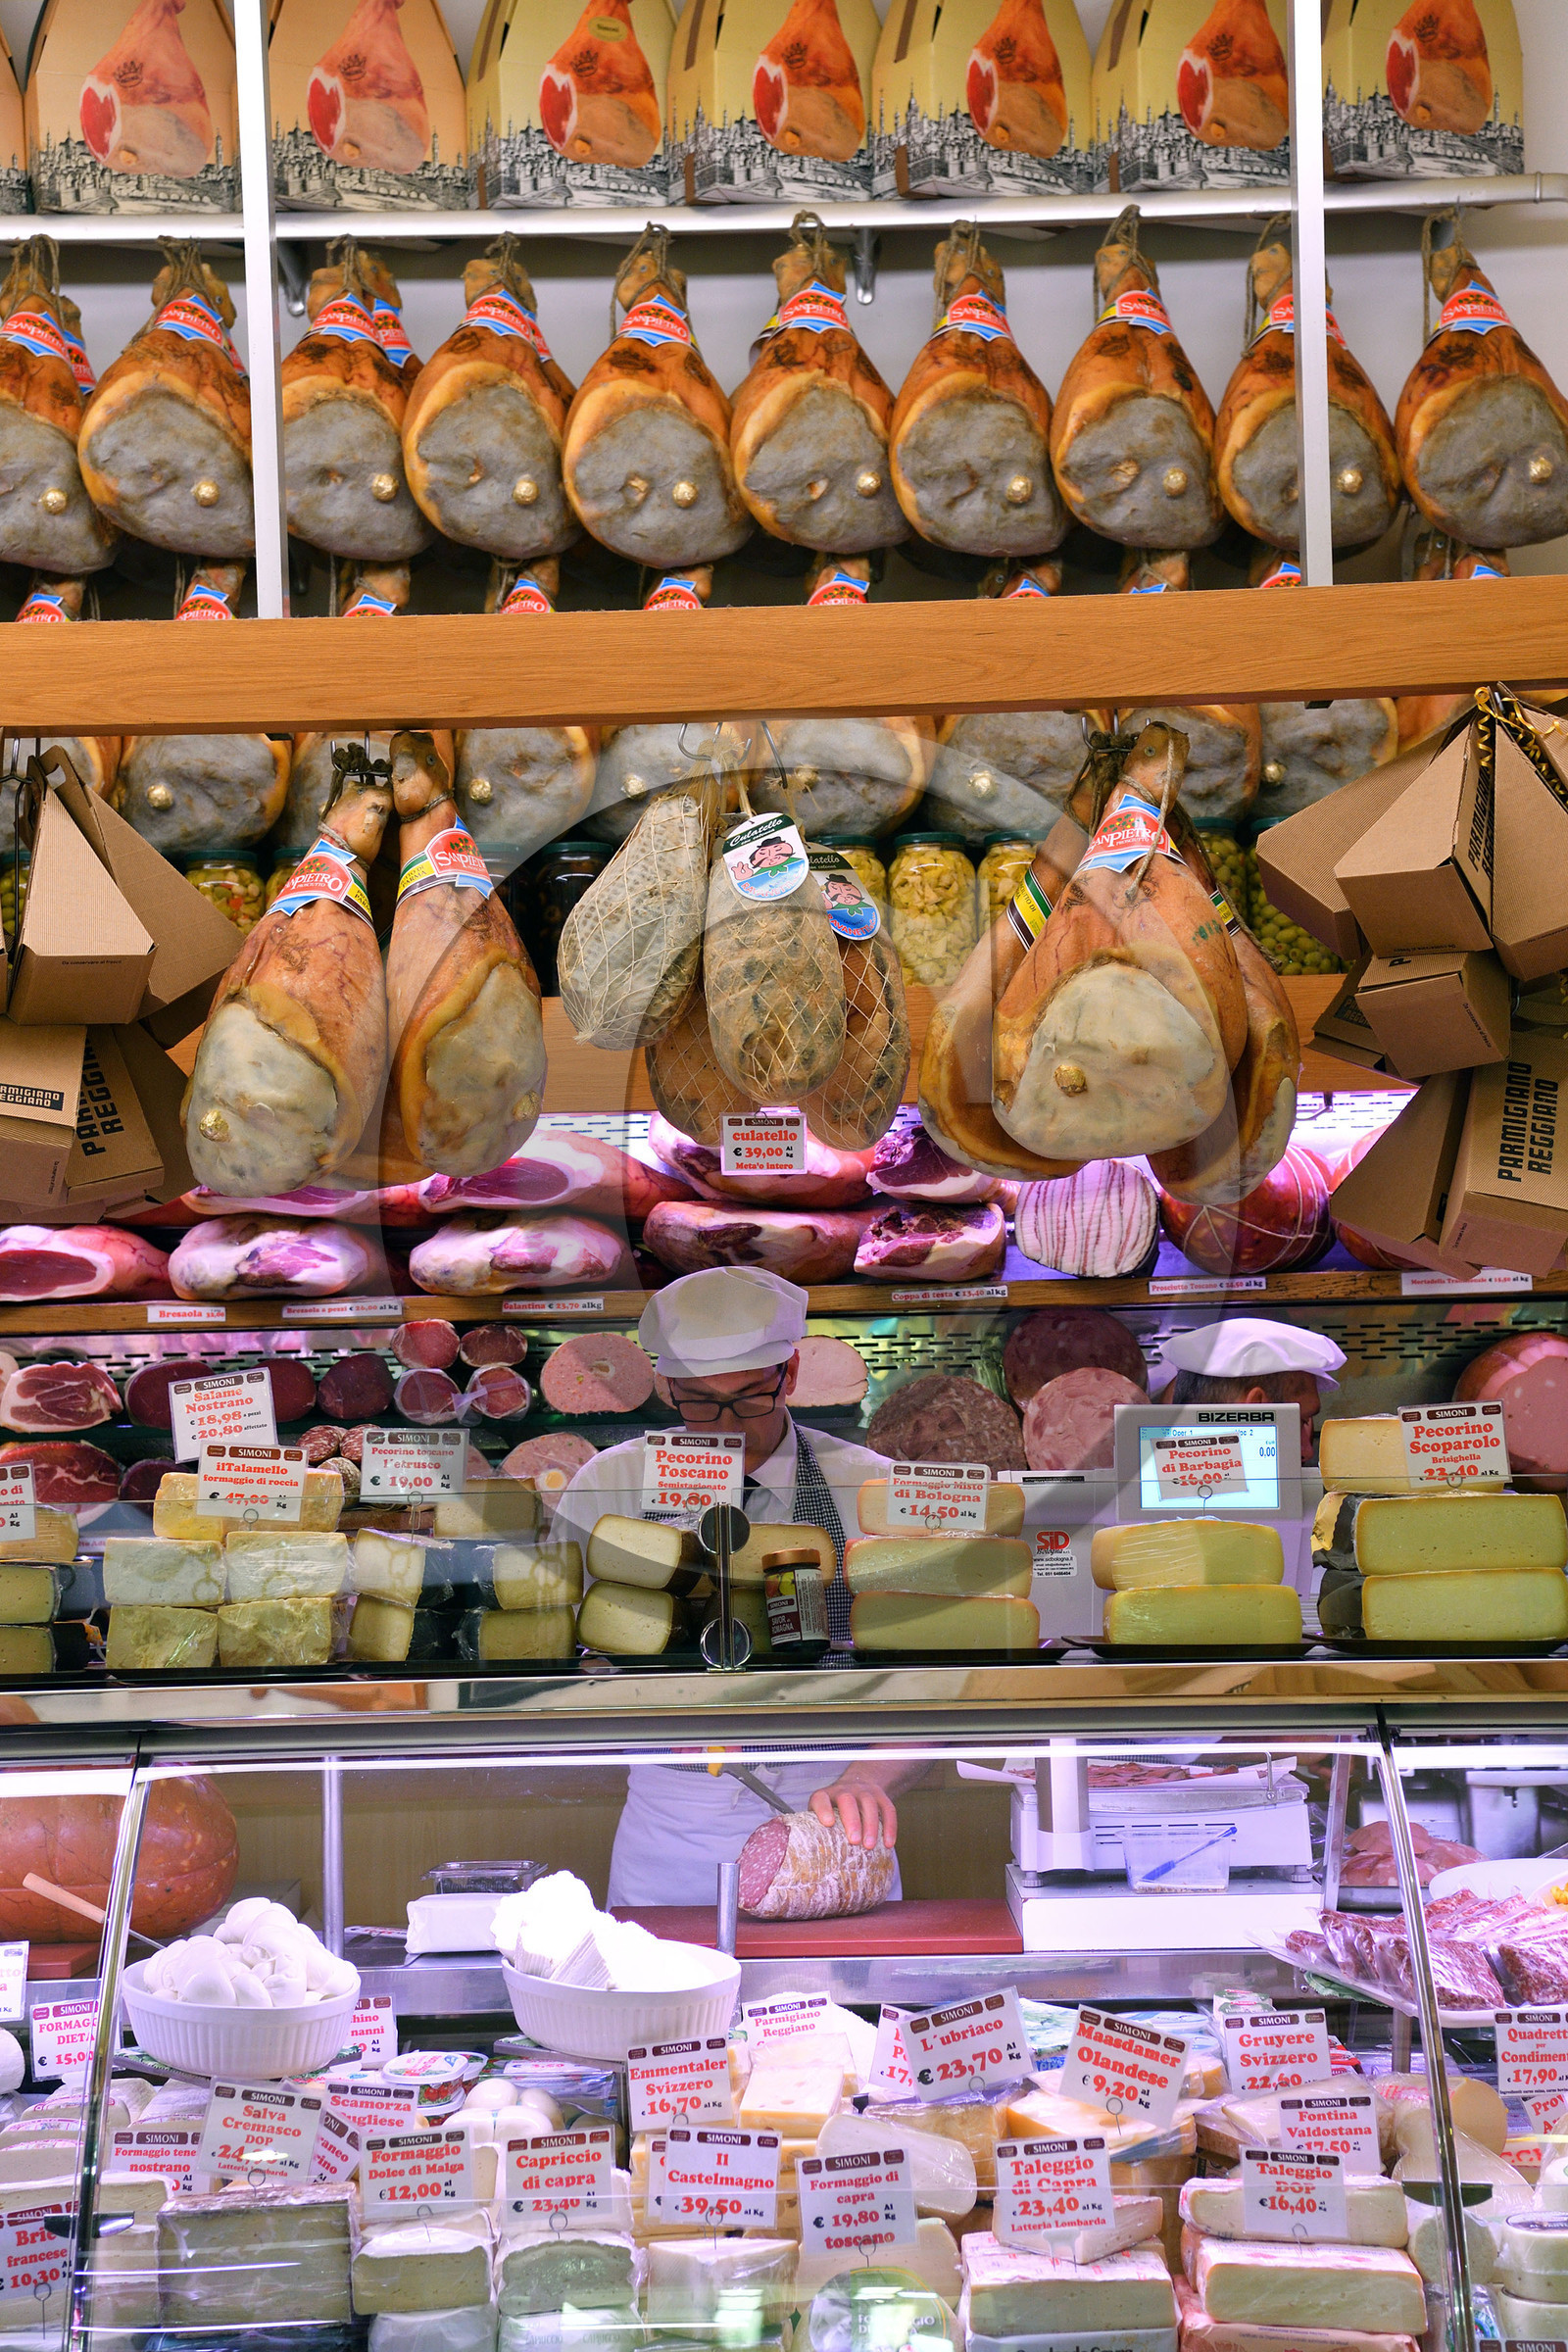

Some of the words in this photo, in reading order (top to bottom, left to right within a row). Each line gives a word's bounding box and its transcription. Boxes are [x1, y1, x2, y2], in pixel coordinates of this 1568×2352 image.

[729, 817, 783, 848] Culatello
[0, 1085, 61, 1102] RMIGIANO
[0, 1094, 52, 1107] EGGIANO
[1497, 1061, 1532, 1183] PARMIGIANO
[1528, 1078, 1559, 1175] REGGIANO
[732, 1129, 798, 1142] culatello
[733, 1147, 742, 1156] €
[745, 1147, 783, 1159] 39,00
[765, 1161, 794, 1170] intero
[1152, 1283, 1188, 1292] Prosciutto
[893, 1293, 920, 1301] Coppa
[159, 1310, 203, 1319] Bresaola
[203, 1377, 235, 1390] SIMONI
[193, 1388, 243, 1402] Salame
[184, 1396, 254, 1414] Nostrano
[197, 1410, 242, 1427] 18,98
[1198, 1411, 1275, 1423] BIZERBA
[1435, 1408, 1468, 1419] SIMONI
[198, 1424, 243, 1440] 20,80
[1413, 1421, 1494, 1439] Pecorino
[397, 1434, 430, 1444] SIMONI
[679, 1438, 710, 1446] SIMONI
[1184, 1439, 1211, 1447] SIMONI
[1409, 1435, 1500, 1454] Scoparolo
[238, 1447, 272, 1458] SIMONI
[371, 1446, 415, 1456] Pecorino
[656, 1450, 733, 1465] Pecorino
[1169, 1446, 1232, 1460] Pecorino
[1432, 1453, 1482, 1464] Brisighella
[216, 1461, 289, 1475] ilTalamello
[658, 1464, 729, 1480] Toscano
[922, 1468, 956, 1477] SIMONI
[1161, 1463, 1176, 1473] di
[1179, 1458, 1243, 1474] Barbagia
[203, 1474, 255, 1486] formaggio
[256, 1477, 267, 1486] di
[268, 1478, 299, 1488] roccia
[369, 1475, 380, 1486] €
[389, 1476, 433, 1490] 19,00
[894, 1489, 910, 1498] di
[915, 1490, 981, 1504] Bologna
[909, 1504, 959, 1520] 14,50
[60, 2003, 91, 2015] SIMONI
[774, 2002, 802, 2013] SIMONI
[940, 2004, 975, 2023] SIMONI
[754, 2010, 821, 2027] Parmigiano
[1258, 2016, 1292, 2026] SIMONI
[1525, 2014, 1553, 2023] SIMONI
[762, 2022, 816, 2037] Reggiano
[1113, 2022, 1152, 2041] SIMONI
[1076, 2022, 1181, 2068] Maasdamer
[1238, 2033, 1315, 2048] Gruyere
[660, 2042, 693, 2055] SIMONI
[917, 2068, 934, 2085] €
[936, 2047, 1004, 2082] 23,70
[1077, 2045, 1169, 2088] Olandese
[1240, 2052, 1318, 2068] Svizzero
[629, 2058, 727, 2081] Emmentaler
[1512, 2068, 1558, 2085] 17,90
[357, 2087, 385, 2096] SIMONI
[645, 2079, 713, 2096] Svizzero
[1093, 2074, 1139, 2101] 9,20
[250, 2092, 286, 2105] SIMONI
[330, 2094, 412, 2112] Scamorza
[647, 2095, 702, 2116] 16,70
[1310, 2098, 1342, 2107] SIMONI
[242, 2105, 286, 2122] Salva
[1298, 2109, 1358, 2122] Fontina
[221, 2116, 302, 2137] Cremasco
[1286, 2126, 1373, 2138] Valdostana
[145, 2133, 179, 2143] SIMONI
[245, 2134, 273, 2146] DOP
[398, 2135, 433, 2146] SIMONI
[540, 2135, 577, 2148] SIMONI
[706, 2132, 742, 2145] SIMONI
[115, 2146, 171, 2158] Formaggio
[371, 2143, 462, 2164] Formaggio
[1033, 2142, 1068, 2154] SIMONI
[515, 2148, 603, 2171] Capriccio
[715, 2152, 730, 2167] Il
[834, 2155, 871, 2169] SIMONI
[1277, 2153, 1308, 2163] SIMONI
[129, 2162, 191, 2173] nostrano
[368, 2168, 406, 2180] Dolce
[409, 2165, 422, 2176] di
[425, 2162, 465, 2175] Malga
[1010, 2155, 1095, 2177] Taleggio
[1256, 2162, 1333, 2180] Taleggio
[522, 2175, 541, 2191] di
[544, 2173, 596, 2188] capra
[667, 2170, 775, 2191] Castelmagno
[809, 2174, 883, 2192] Formaggio
[885, 2170, 900, 2182] di
[387, 2181, 442, 2202] 12,00
[836, 2191, 875, 2205] capra
[680, 2196, 743, 2217] 39,50
[1017, 2196, 1080, 2218] 23,40
[1267, 2194, 1317, 2216] 16,40
[812, 2216, 825, 2229] €
[831, 2210, 880, 2229] 19,80
[1010, 2222, 1053, 2232] Latteria
[1054, 2217, 1106, 2229] Lombarda
[824, 2231, 896, 2250] toscano
[7, 2247, 68, 2269] francese
[10, 2267, 61, 2289] 10,30
